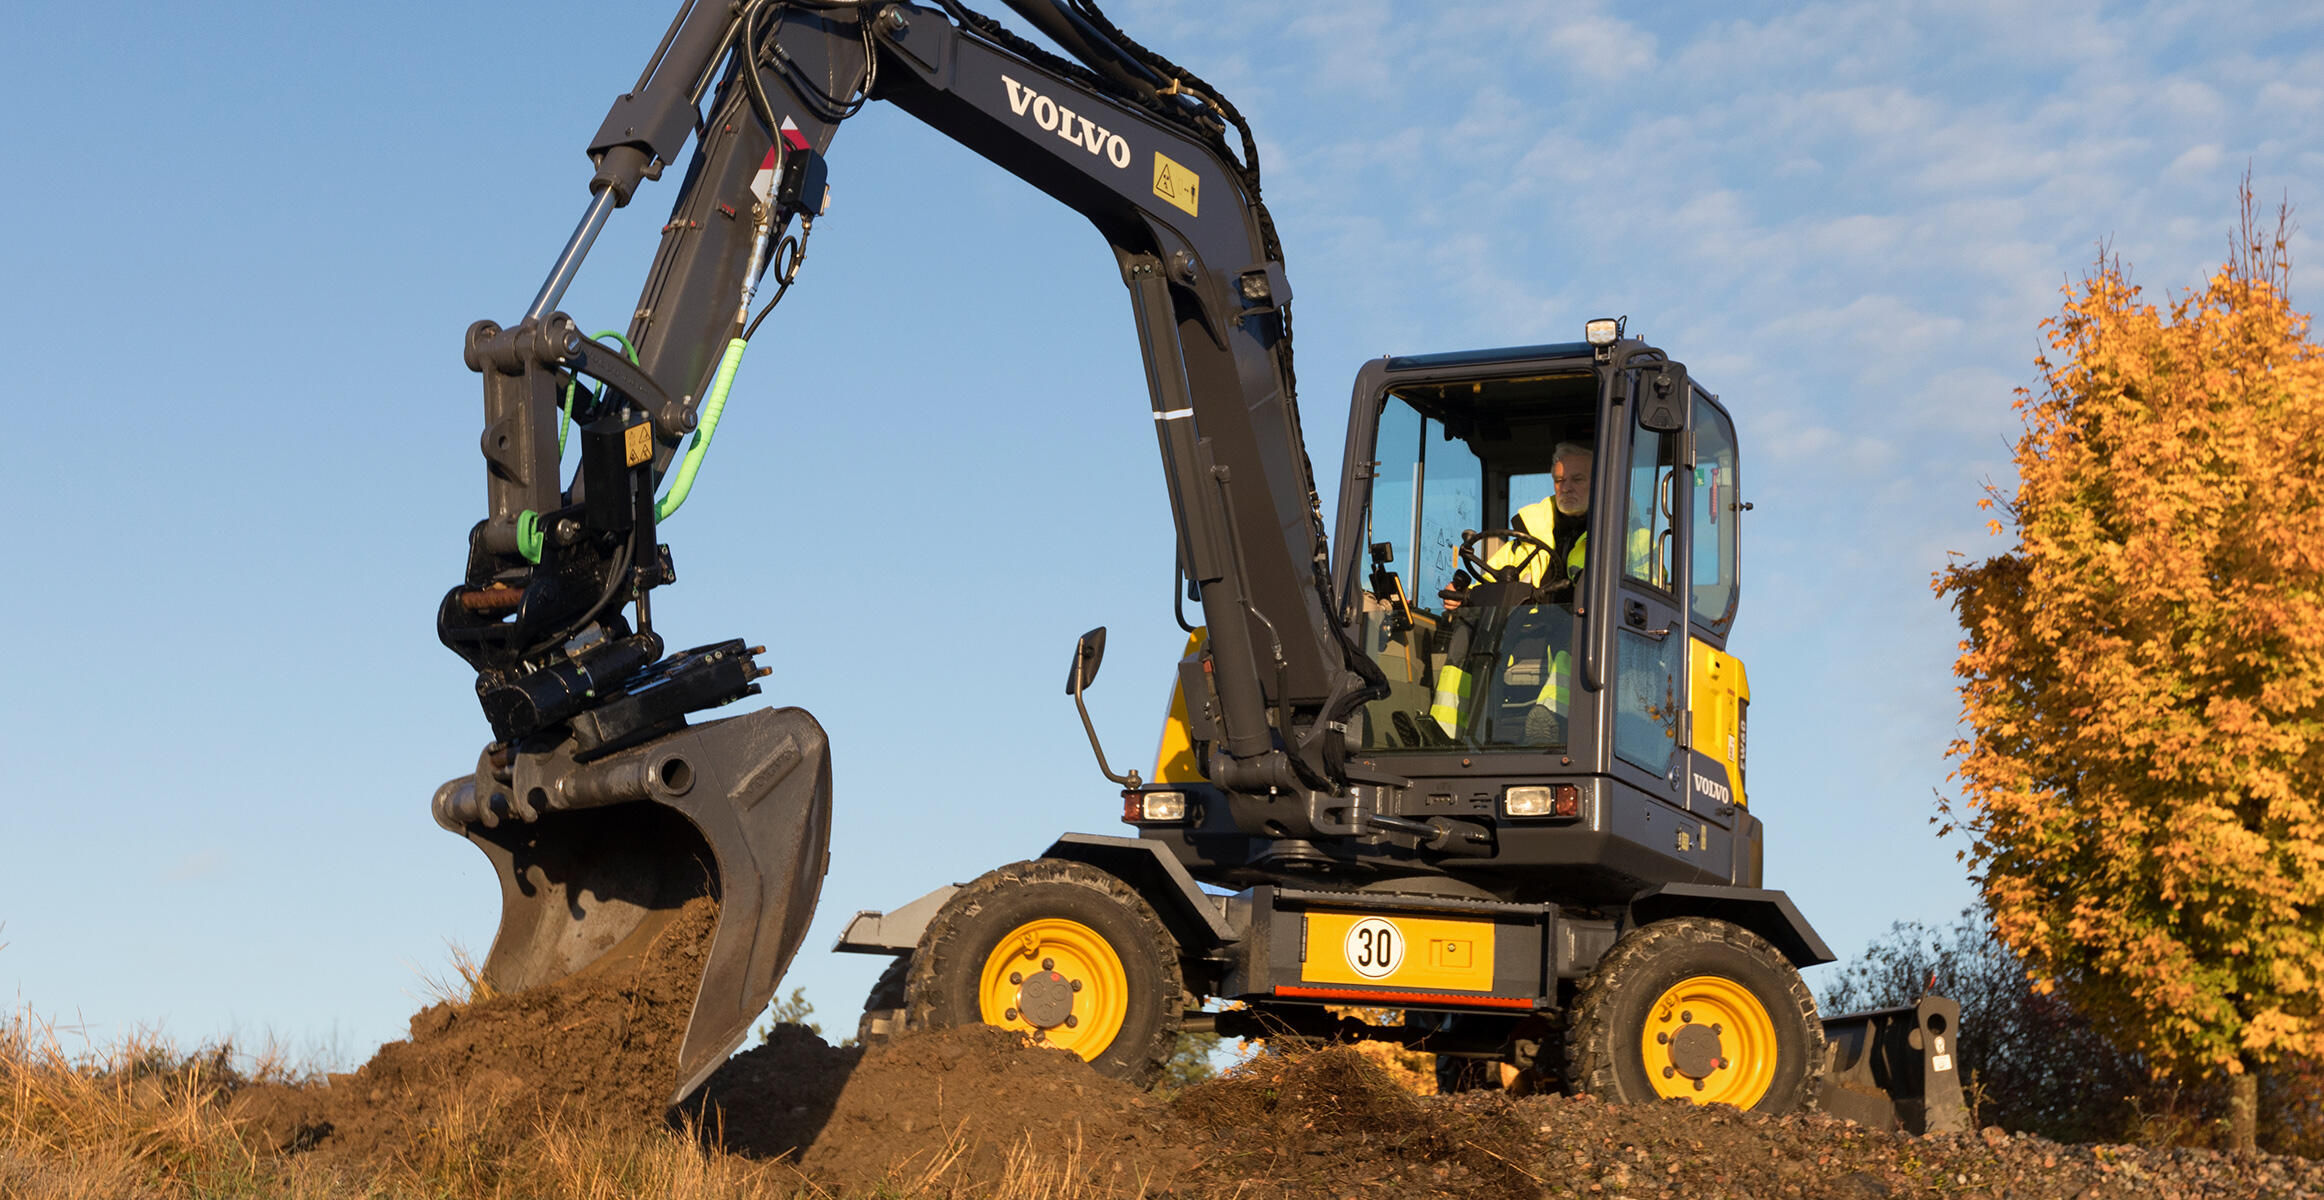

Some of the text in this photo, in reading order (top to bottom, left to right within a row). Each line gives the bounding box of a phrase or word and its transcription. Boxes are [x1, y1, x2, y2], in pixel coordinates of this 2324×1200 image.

[1001, 75, 1131, 169] VOLVO
[1693, 773, 1729, 804] VOLVO
[1358, 928, 1391, 968] 30
